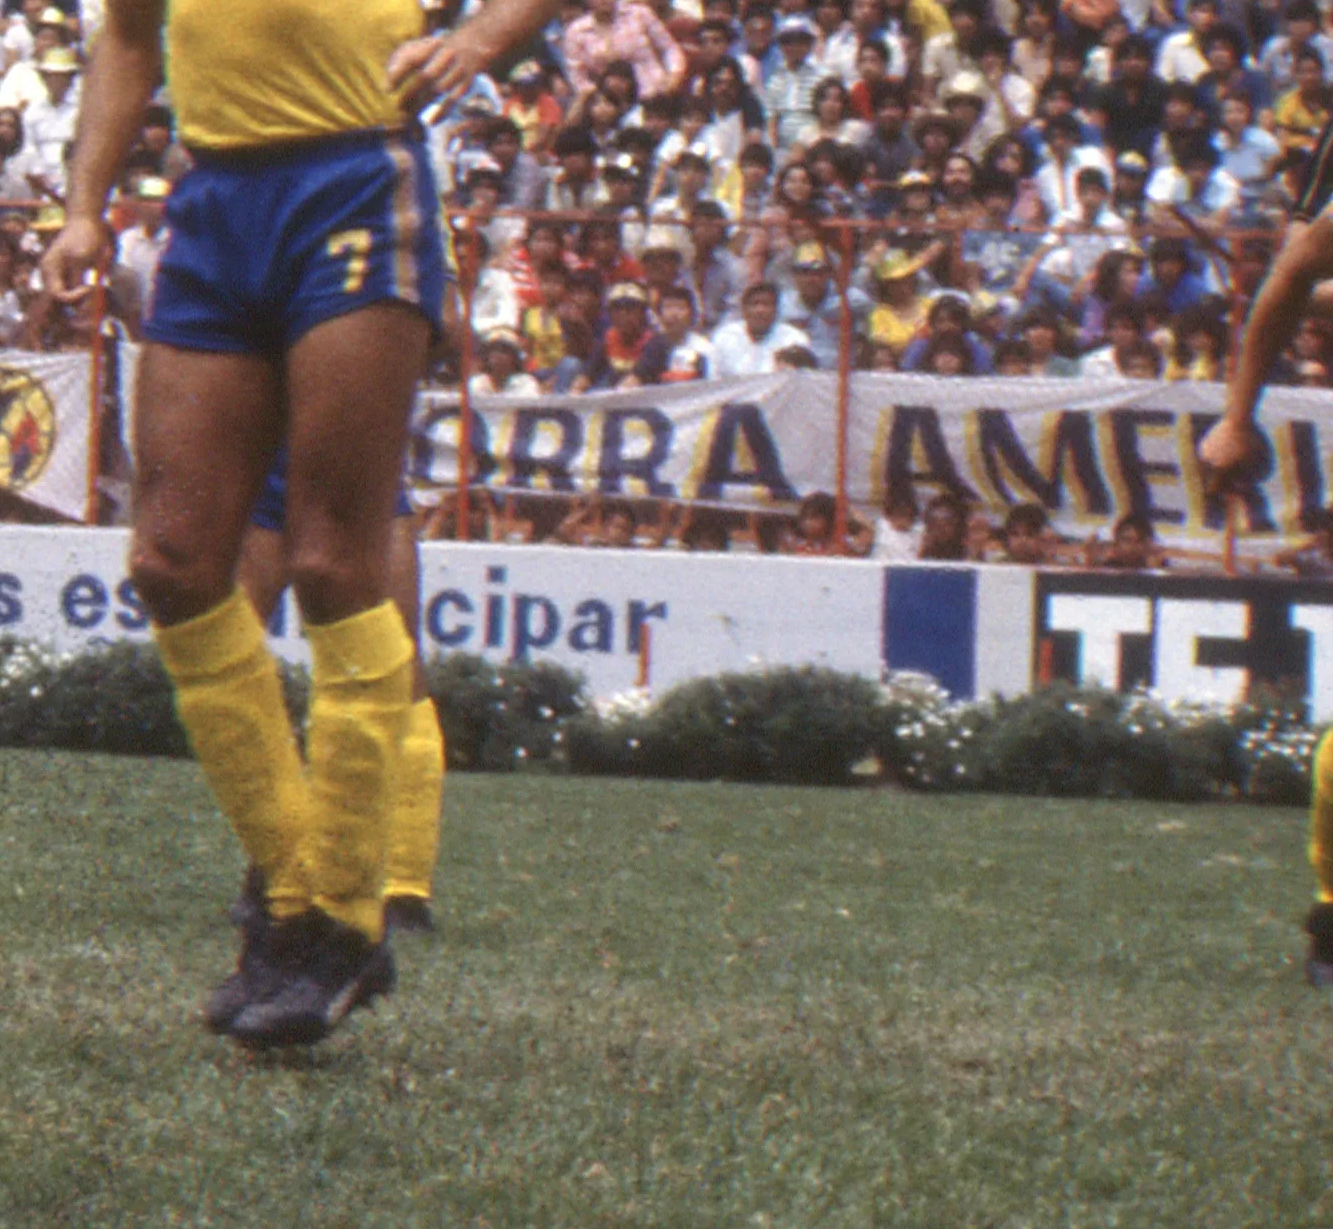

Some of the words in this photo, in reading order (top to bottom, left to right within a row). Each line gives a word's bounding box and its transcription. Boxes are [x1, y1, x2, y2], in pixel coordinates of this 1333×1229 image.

[327, 228, 373, 293] 7
[405, 403, 801, 503] ORRA
[870, 404, 1333, 537] AMERI
